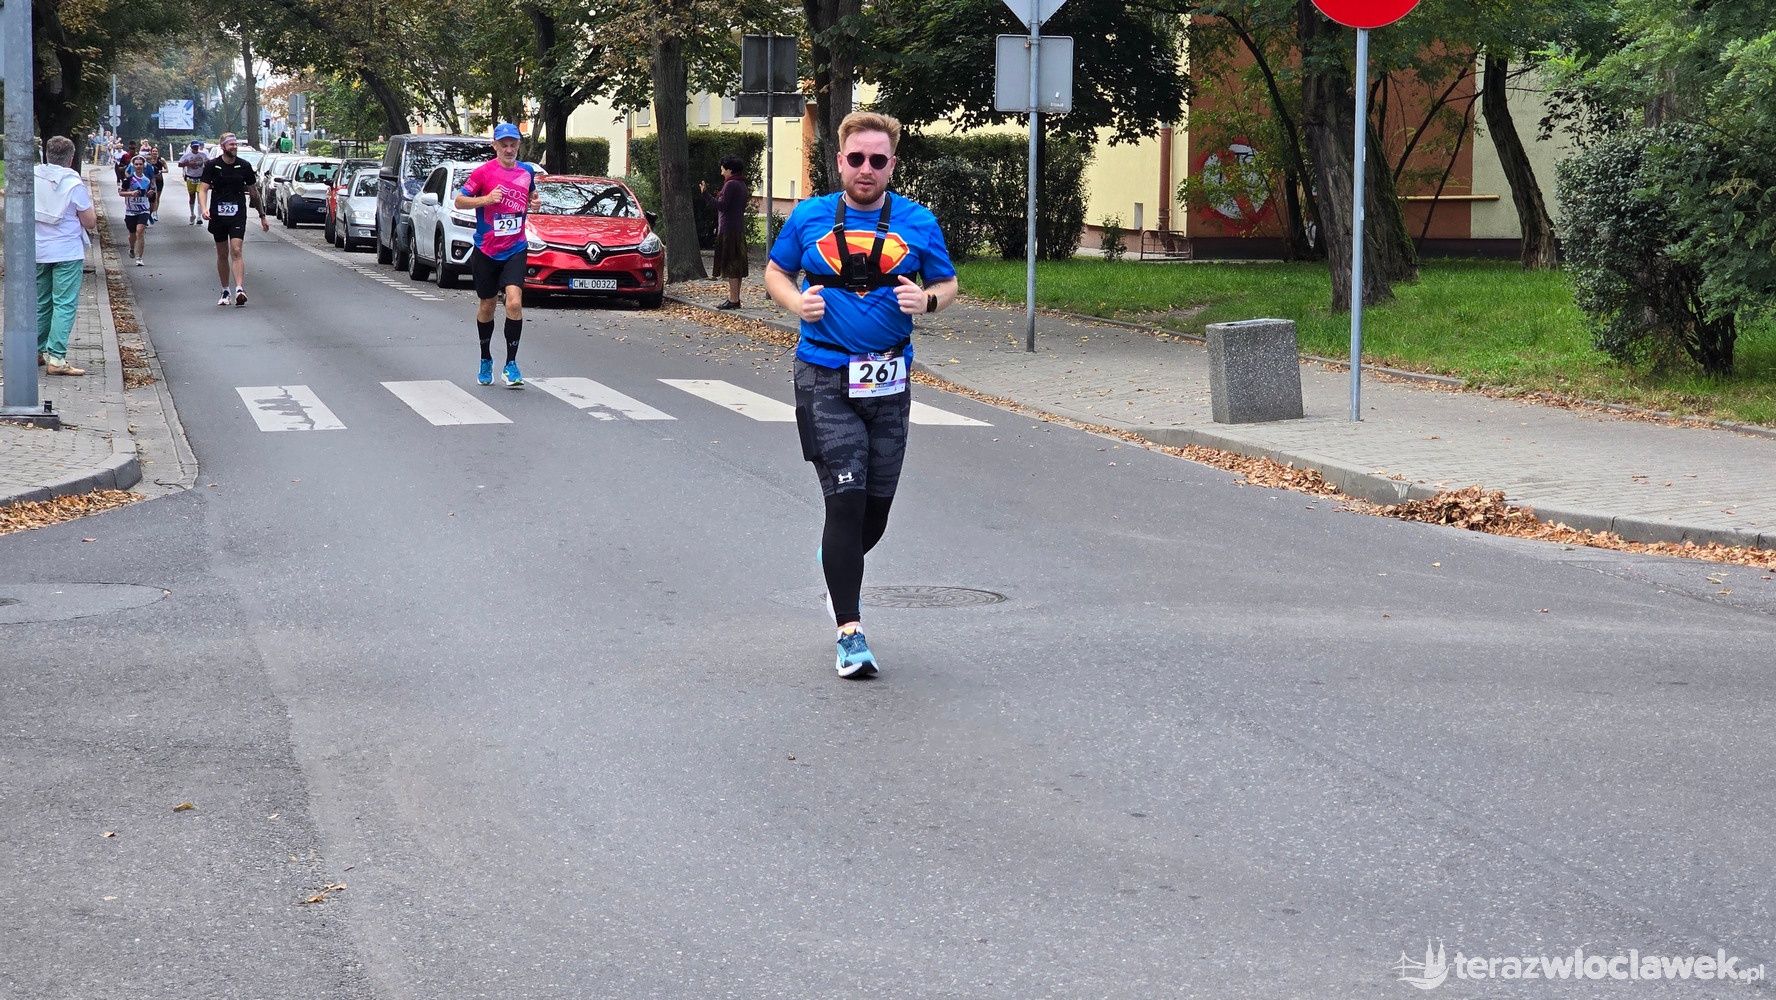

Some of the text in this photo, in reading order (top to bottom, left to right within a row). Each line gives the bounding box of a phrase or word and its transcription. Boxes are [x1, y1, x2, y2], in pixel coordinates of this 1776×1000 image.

[220, 205, 236, 214] 526
[498, 219, 518, 230] 291
[591, 279, 616, 289] 00322
[859, 360, 898, 383] 267
